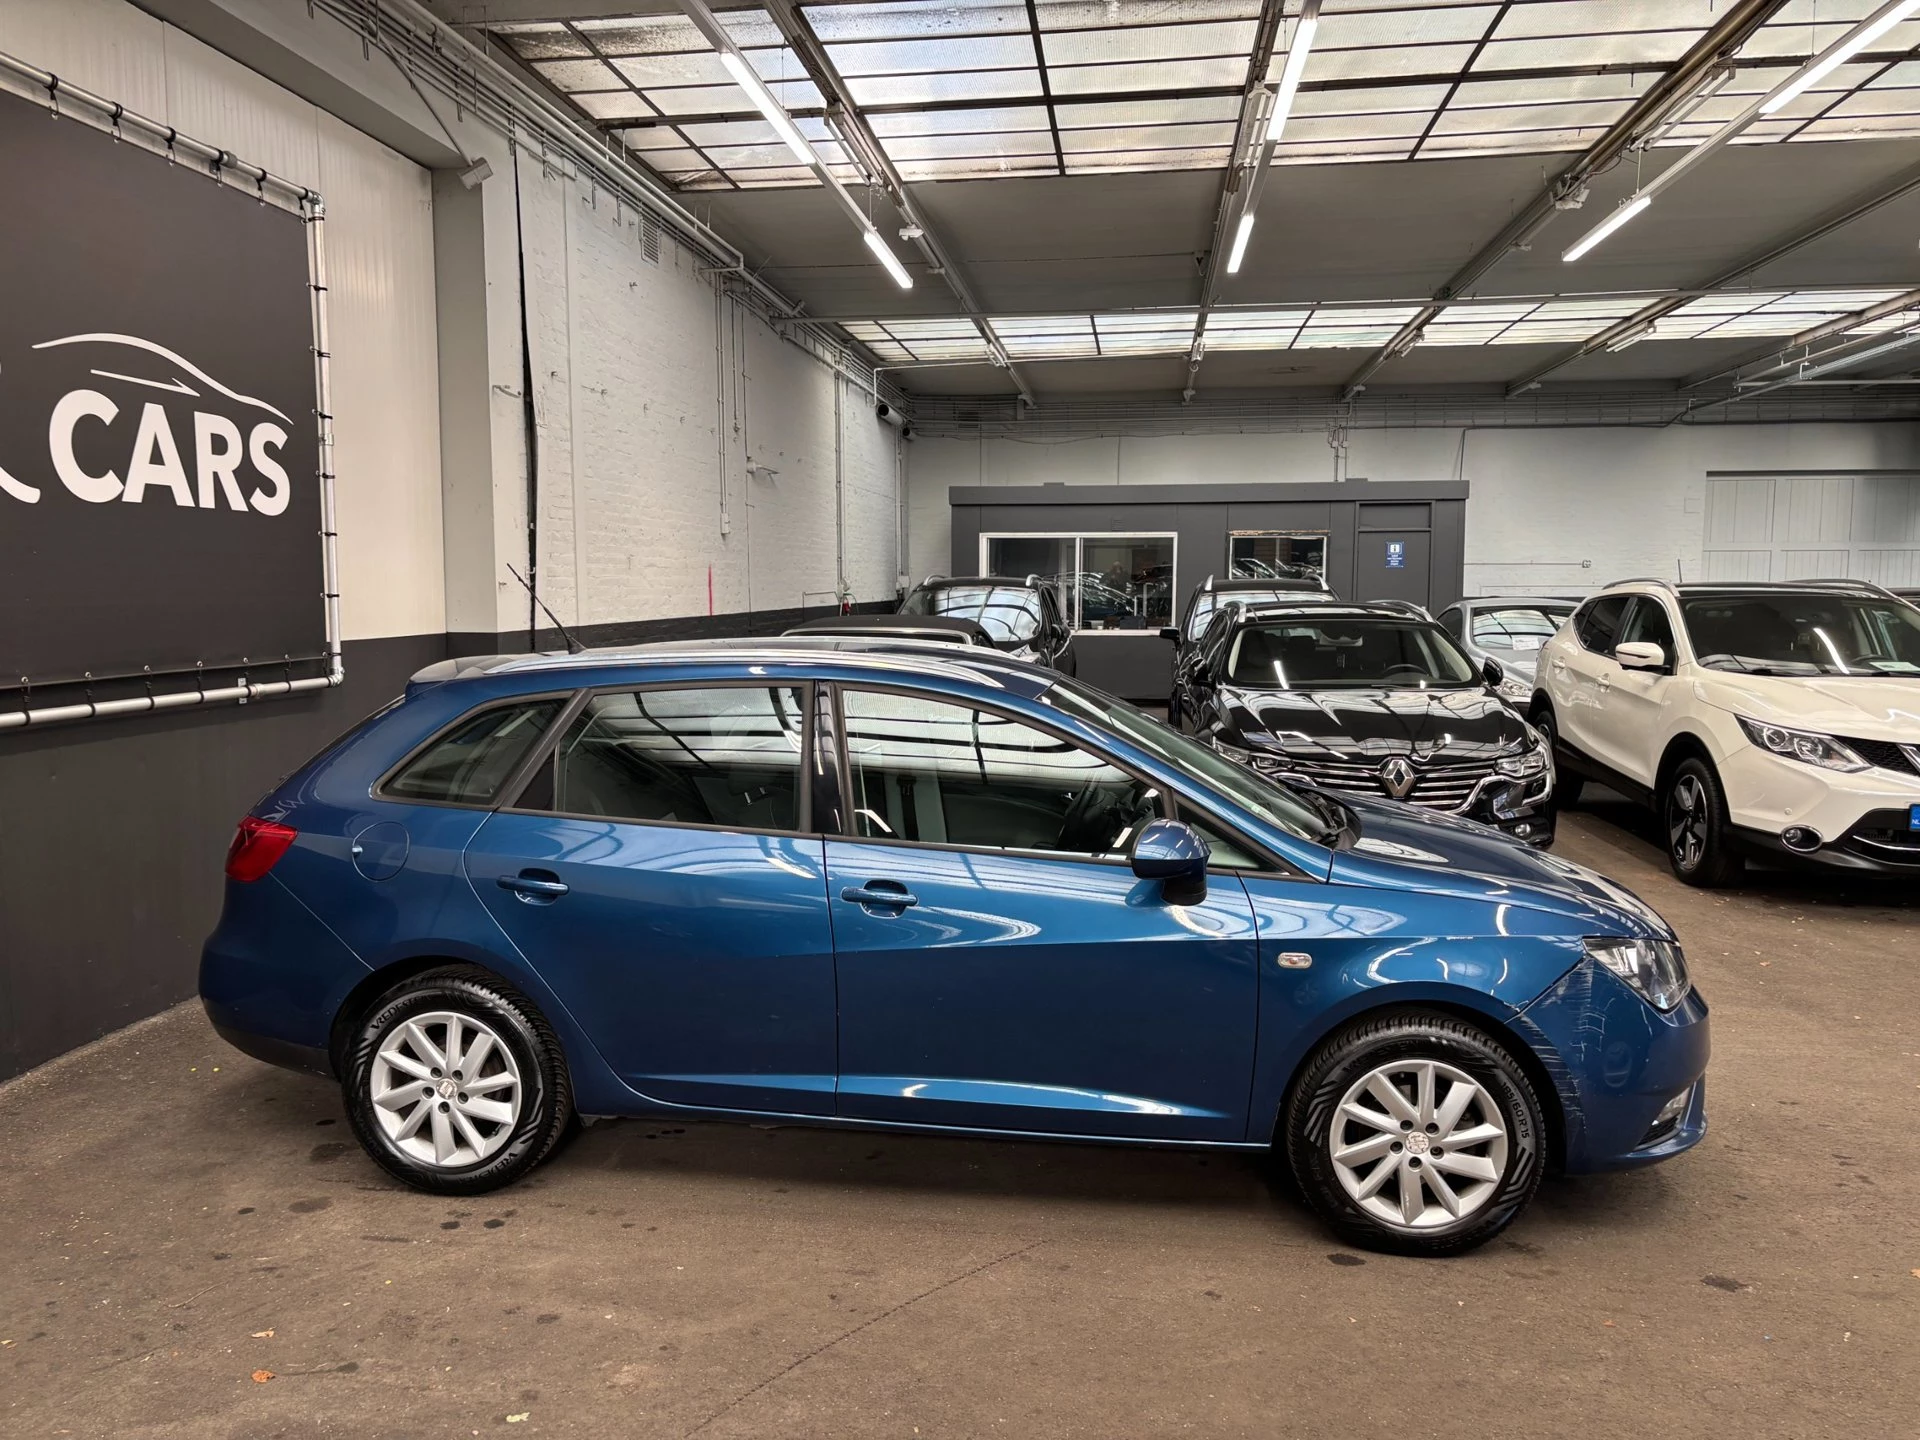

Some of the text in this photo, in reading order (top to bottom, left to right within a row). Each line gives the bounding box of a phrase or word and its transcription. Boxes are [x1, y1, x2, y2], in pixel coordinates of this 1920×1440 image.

[49, 389, 291, 516] CARS
[1502, 1081, 1530, 1139] 185/60 R 15
